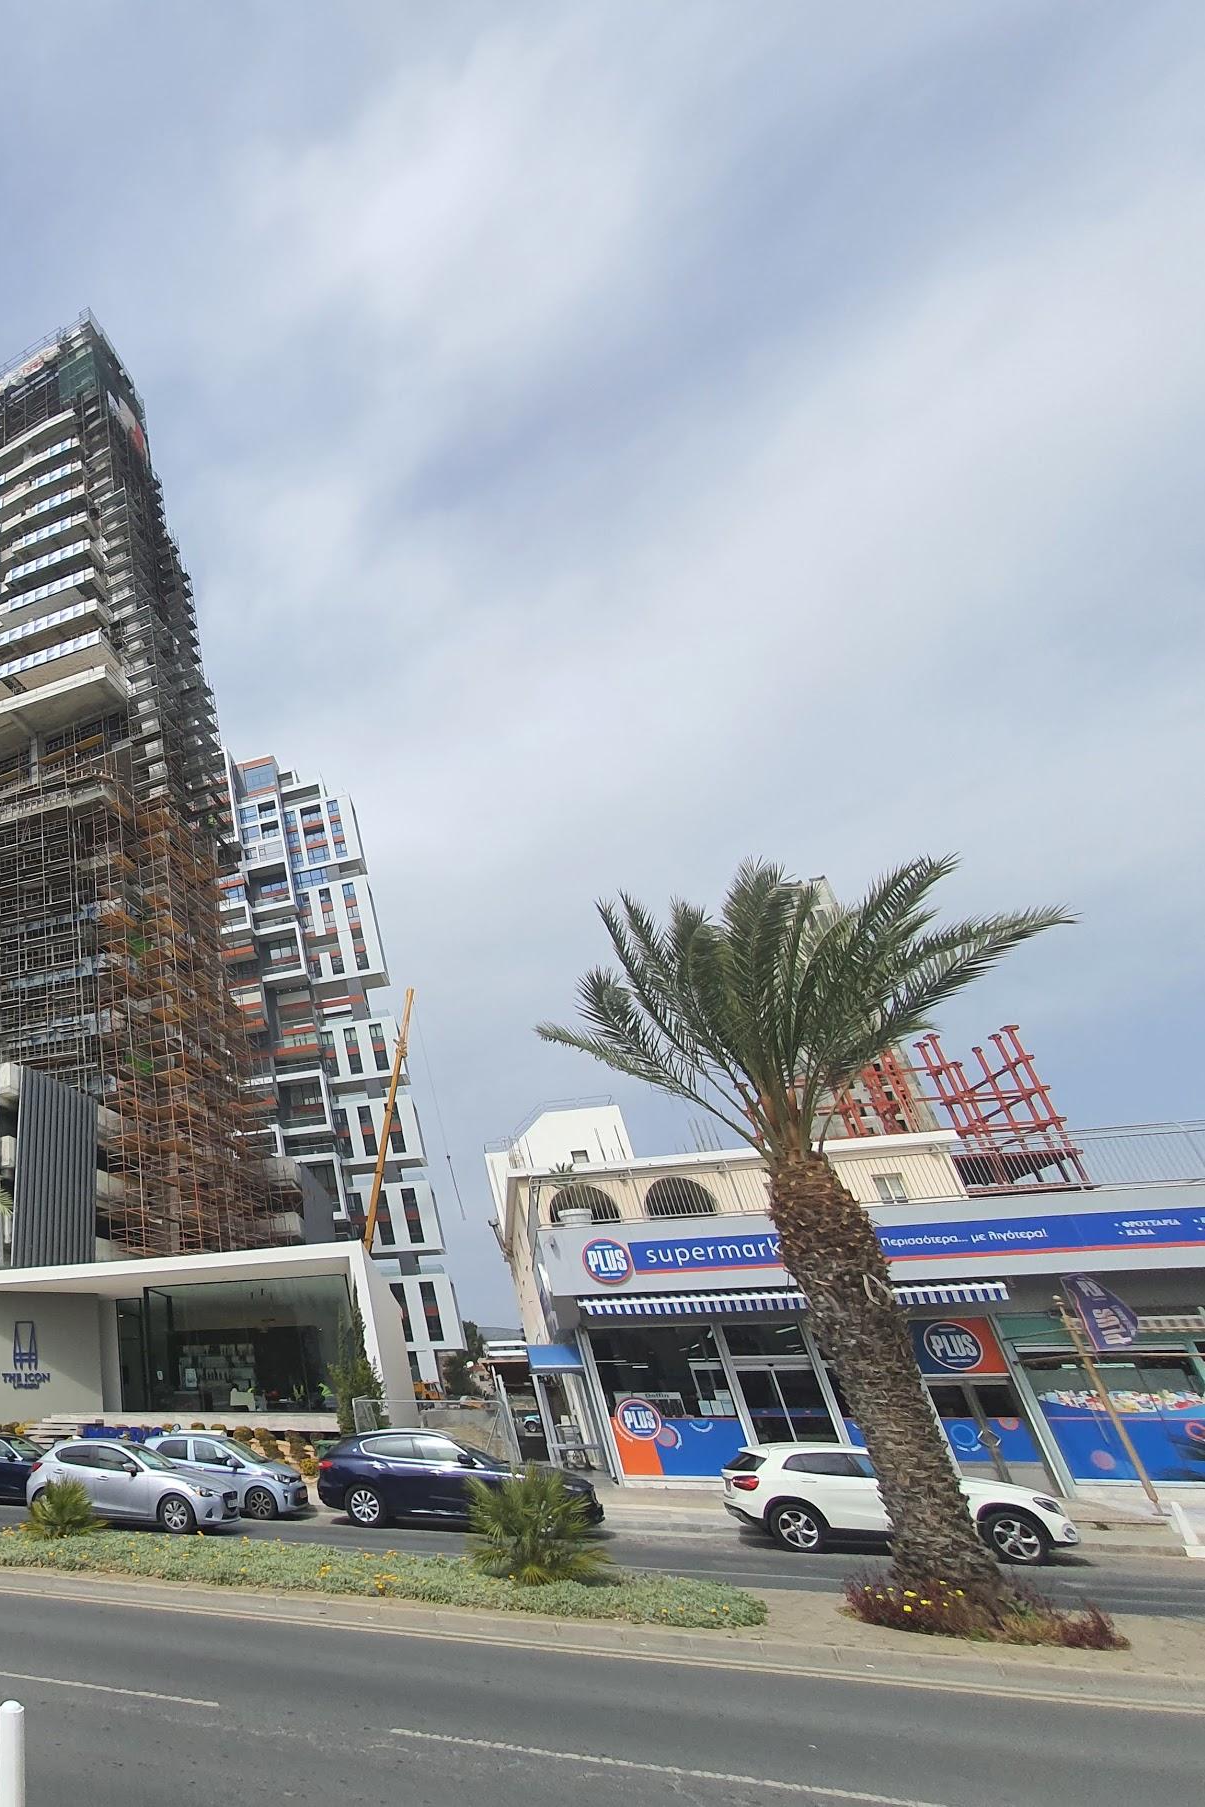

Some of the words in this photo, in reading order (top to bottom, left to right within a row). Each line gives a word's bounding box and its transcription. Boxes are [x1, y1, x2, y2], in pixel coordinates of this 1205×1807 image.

[970, 1234, 986, 1243] με
[587, 1249, 628, 1272] PLUS
[1092, 1308, 1132, 1345] PLUS
[930, 1334, 978, 1357] PLUS
[2, 1372, 22, 1384] THE
[24, 1372, 51, 1383] ICON
[624, 1411, 656, 1429] PLUS
